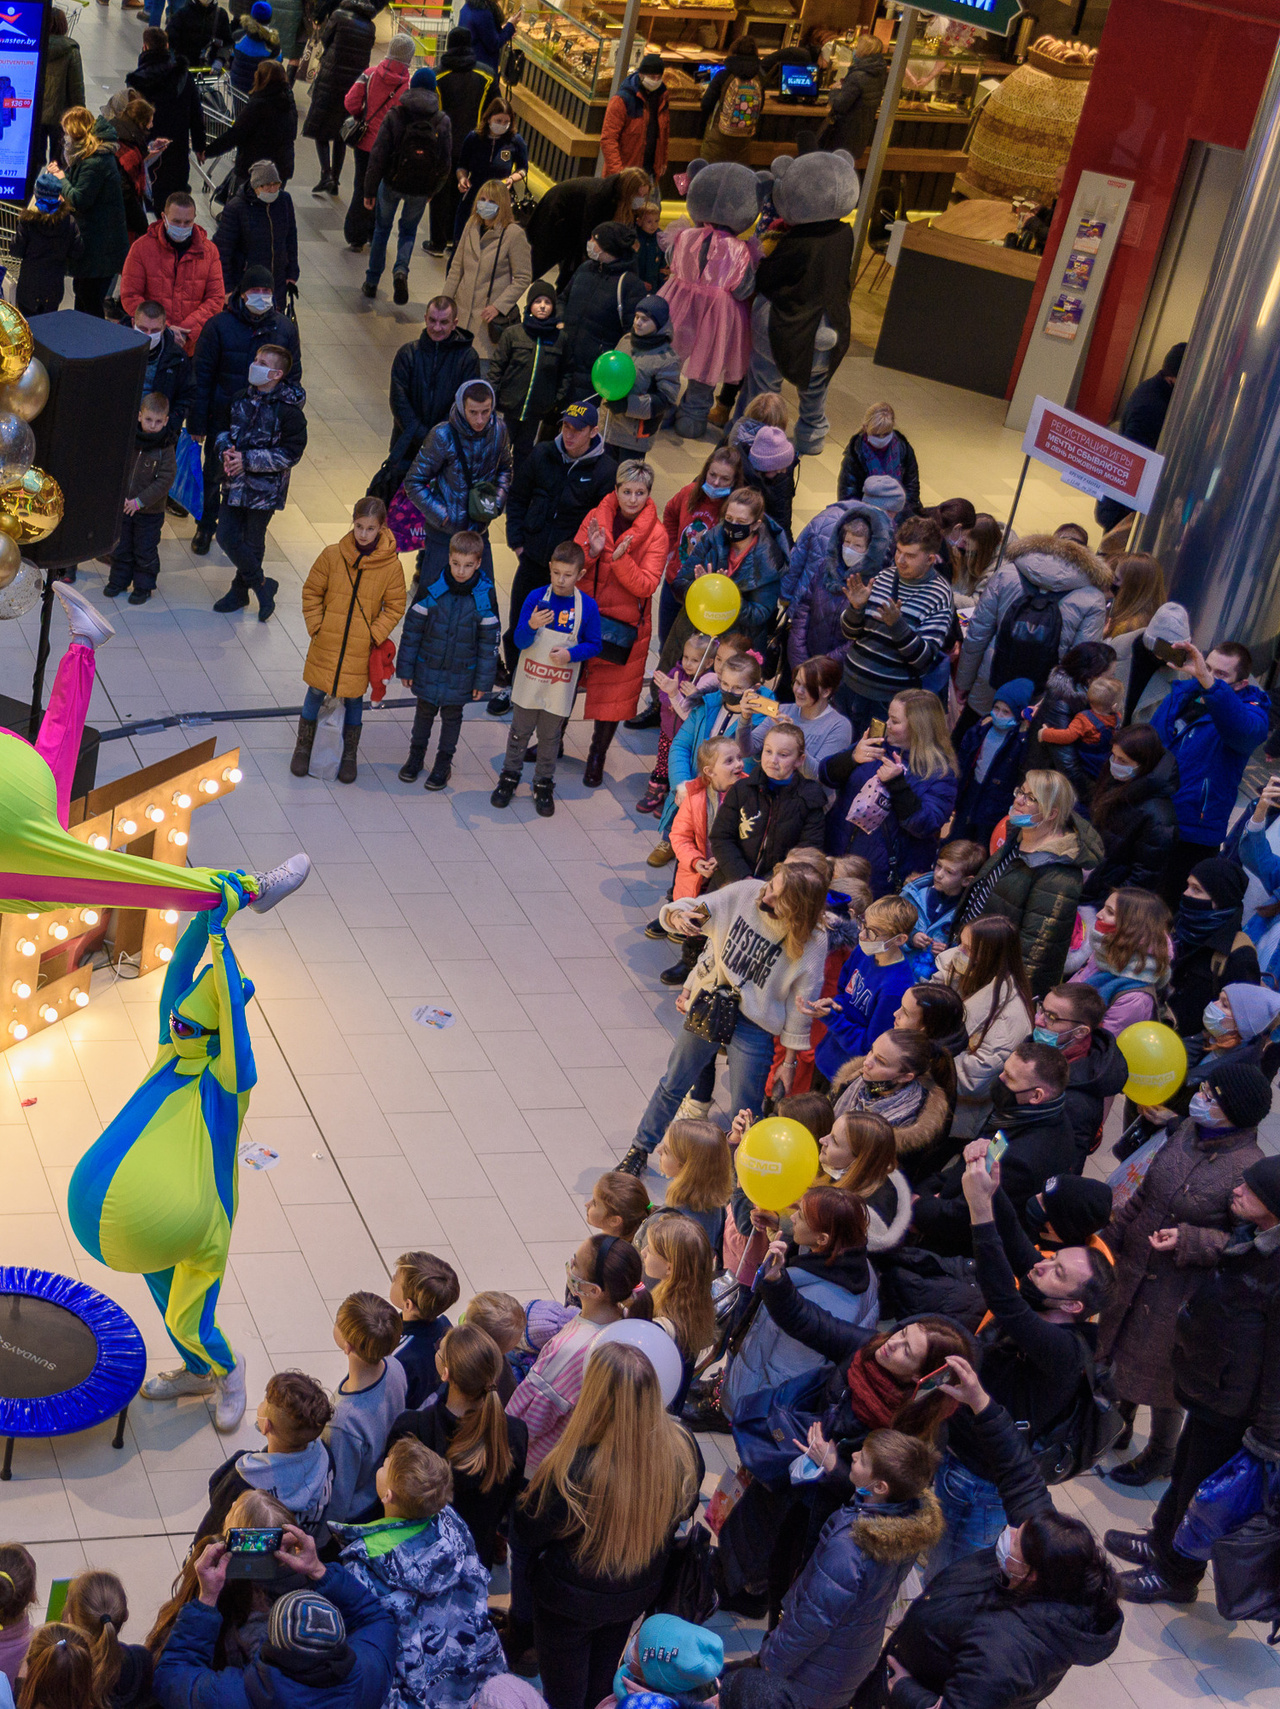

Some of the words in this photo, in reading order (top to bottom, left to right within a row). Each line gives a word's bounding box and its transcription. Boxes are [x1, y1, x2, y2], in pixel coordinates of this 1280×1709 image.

[1047, 433, 1075, 453] МЕЧТЫ
[1076, 448, 1130, 479] СБЫВАЮТСЯ
[1051, 419, 1108, 456] РЕГИСТРАЦИЯ
[1109, 448, 1134, 467] ИГРЫ
[1068, 453, 1104, 475] РОЖДЕНИЯ
[525, 661, 571, 680] МОМО
